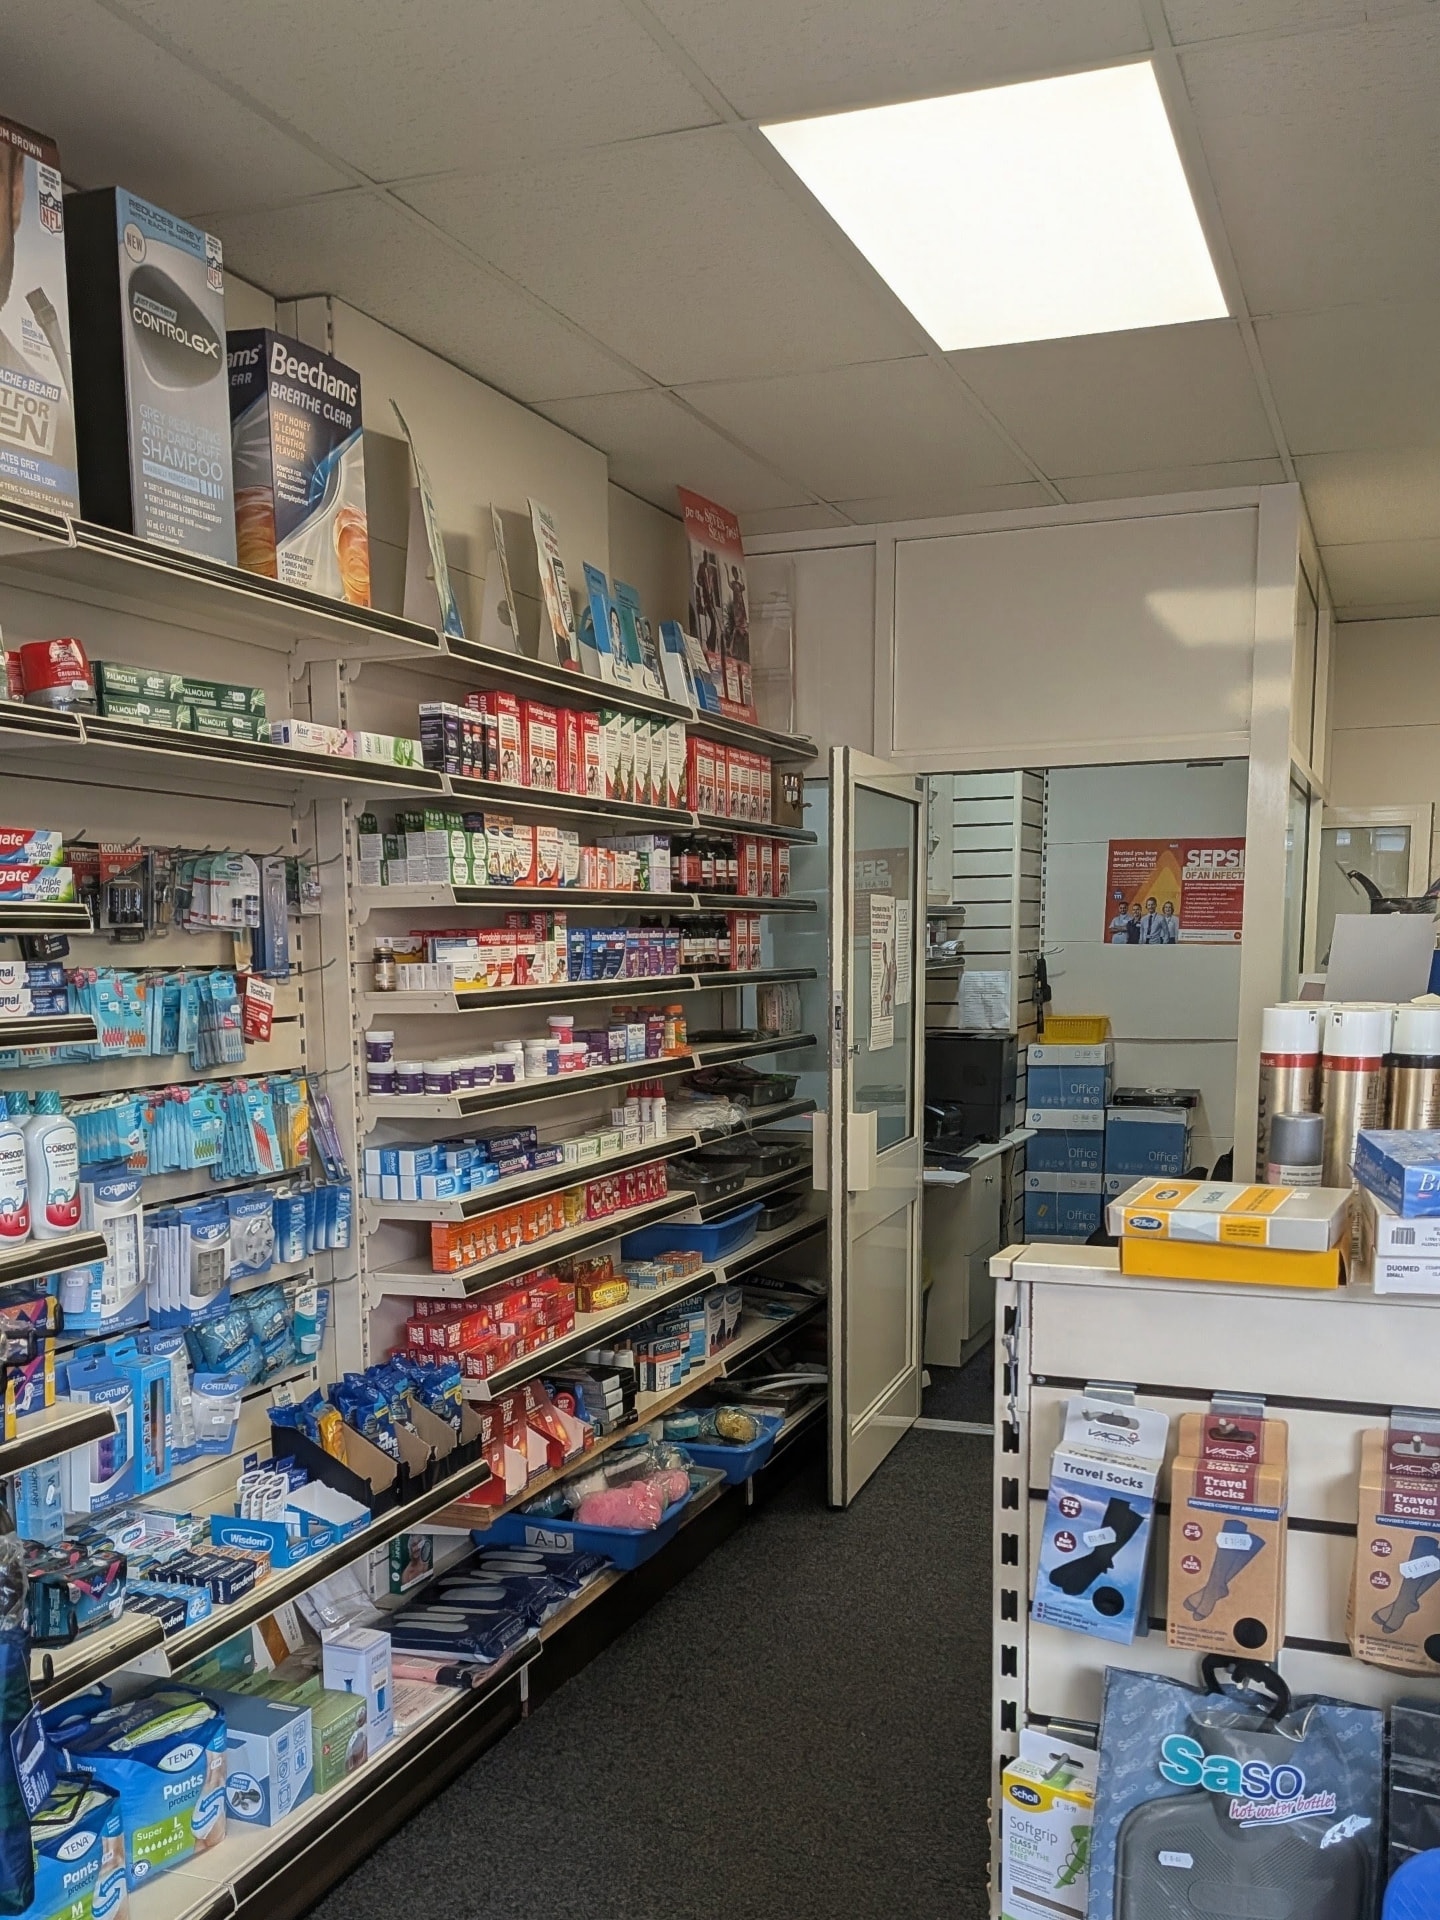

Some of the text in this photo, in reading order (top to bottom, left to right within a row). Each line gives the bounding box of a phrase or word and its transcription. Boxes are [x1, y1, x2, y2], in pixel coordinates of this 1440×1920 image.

[11, 132, 43, 159] BROWN
[41, 206, 62, 230] NFL
[129, 199, 202, 242] REDUCES GREY
[148, 217, 167, 233] EACH
[126, 232, 143, 251] NEW
[208, 268, 222, 287] NFL
[228, 373, 252, 386] EAR
[270, 342, 358, 407] Beechams
[28, 380, 60, 401] BEARD
[13, 393, 50, 420] FOR
[270, 381, 352, 429] BREATHE CLEAR
[139, 403, 221, 446] GREY REDUCING
[273, 411, 312, 432] HOT HONEY
[281, 423, 305, 440] LEMON
[274, 433, 307, 452] MENTHOL
[142, 436, 223, 482] SHAMPOO
[275, 445, 305, 462] FLAVOUR
[20, 456, 40, 472] GREY
[20, 471, 57, 488] FULLER LOOK
[19, 487, 42, 499] COARSE
[42, 493, 61, 506] FACIAL
[61, 499, 74, 510] HAIR
[685, 506, 694, 518] Do
[106, 671, 137, 684] PALMOLIVE
[185, 688, 215, 699] ALMOLIVE
[109, 704, 140, 716] PALMOLIV
[199, 717, 227, 728] PALMOLIVE
[295, 723, 310, 736] Nair
[101, 843, 142, 853] KOMAKT
[1187, 849, 1245, 868] SEPSI
[0, 870, 30, 885] gate
[41, 877, 62, 886] Triple
[1185, 871, 1197, 880] OF
[1197, 871, 1210, 880] AN
[37, 884, 60, 894] Action
[46, 944, 51, 954] 2
[0, 966, 14, 977] nal
[0, 994, 19, 1008] gnal
[1071, 1084, 1100, 1095] Office
[415, 1153, 429, 1163] Savlon
[534, 1150, 556, 1160] Germolene
[1068, 1147, 1098, 1158] Office
[1148, 1151, 1178, 1163] Office
[100, 1181, 138, 1196] FORNA
[437, 1177, 452, 1187] Savlon
[236, 1201, 267, 1214] FORTUNA
[1067, 1210, 1096, 1221] Office
[1386, 1264, 1420, 1273] DUOMED
[447, 1323, 461, 1334] DEEP
[153, 1336, 183, 1351] FORTUNA
[448, 1332, 461, 1343] HEAT
[94, 1385, 130, 1401] FORTUNA
[201, 1381, 240, 1391] FORTUNA
[1088, 1427, 1140, 1445] VACAY
[1205, 1445, 1257, 1459] VACAY
[1068, 1450, 1147, 1471] Travel Socks
[1063, 1462, 1144, 1489] Travel Socks
[1206, 1465, 1247, 1474] Socks
[1203, 1475, 1248, 1490] Travel
[1395, 1484, 1437, 1492] Socks
[1204, 1486, 1245, 1499] Socks
[1062, 1499, 1080, 1509] SIZE
[1393, 1493, 1438, 1507] Travel
[1063, 1507, 1078, 1516] 3-6
[1188, 1500, 1214, 1508] PROVIDES
[1214, 1503, 1241, 1511] COMFORT
[1253, 1507, 1279, 1515] SUPPORT
[1394, 1504, 1436, 1516] Socks
[1186, 1524, 1199, 1532] SIZE
[1377, 1517, 1404, 1525] PROVIDES
[1405, 1519, 1429, 1527] COMFORT
[230, 1533, 269, 1547] Wisdom
[534, 1530, 567, 1549] A-D
[1058, 1537, 1072, 1545] Pair
[1184, 1530, 1201, 1539] 6-9
[1056, 1541, 1074, 1550] Black
[1372, 1545, 1391, 1555] 9-12
[230, 1569, 254, 1594] Fixodent
[167, 1748, 194, 1766] TENA
[77, 1763, 97, 1773] Pants
[163, 1774, 204, 1800] Pants
[230, 1782, 247, 1790] Design
[231, 1777, 248, 1786] Unisex
[168, 1788, 200, 1811] protect+
[1011, 1785, 1039, 1804] Scholl
[1229, 1790, 1337, 1819] hot water bottles
[174, 1816, 182, 1829] L
[136, 1827, 163, 1841] Super
[1010, 1815, 1058, 1846] Softgrip
[64, 1836, 89, 1856] TENA
[1009, 1835, 1038, 1852] CLASS II
[1009, 1843, 1050, 1863] BELOW THE
[1009, 1850, 1029, 1862] KNEE
[63, 1859, 99, 1889] Pants
[67, 1875, 96, 1898] protect+
[71, 1901, 84, 1915] M
